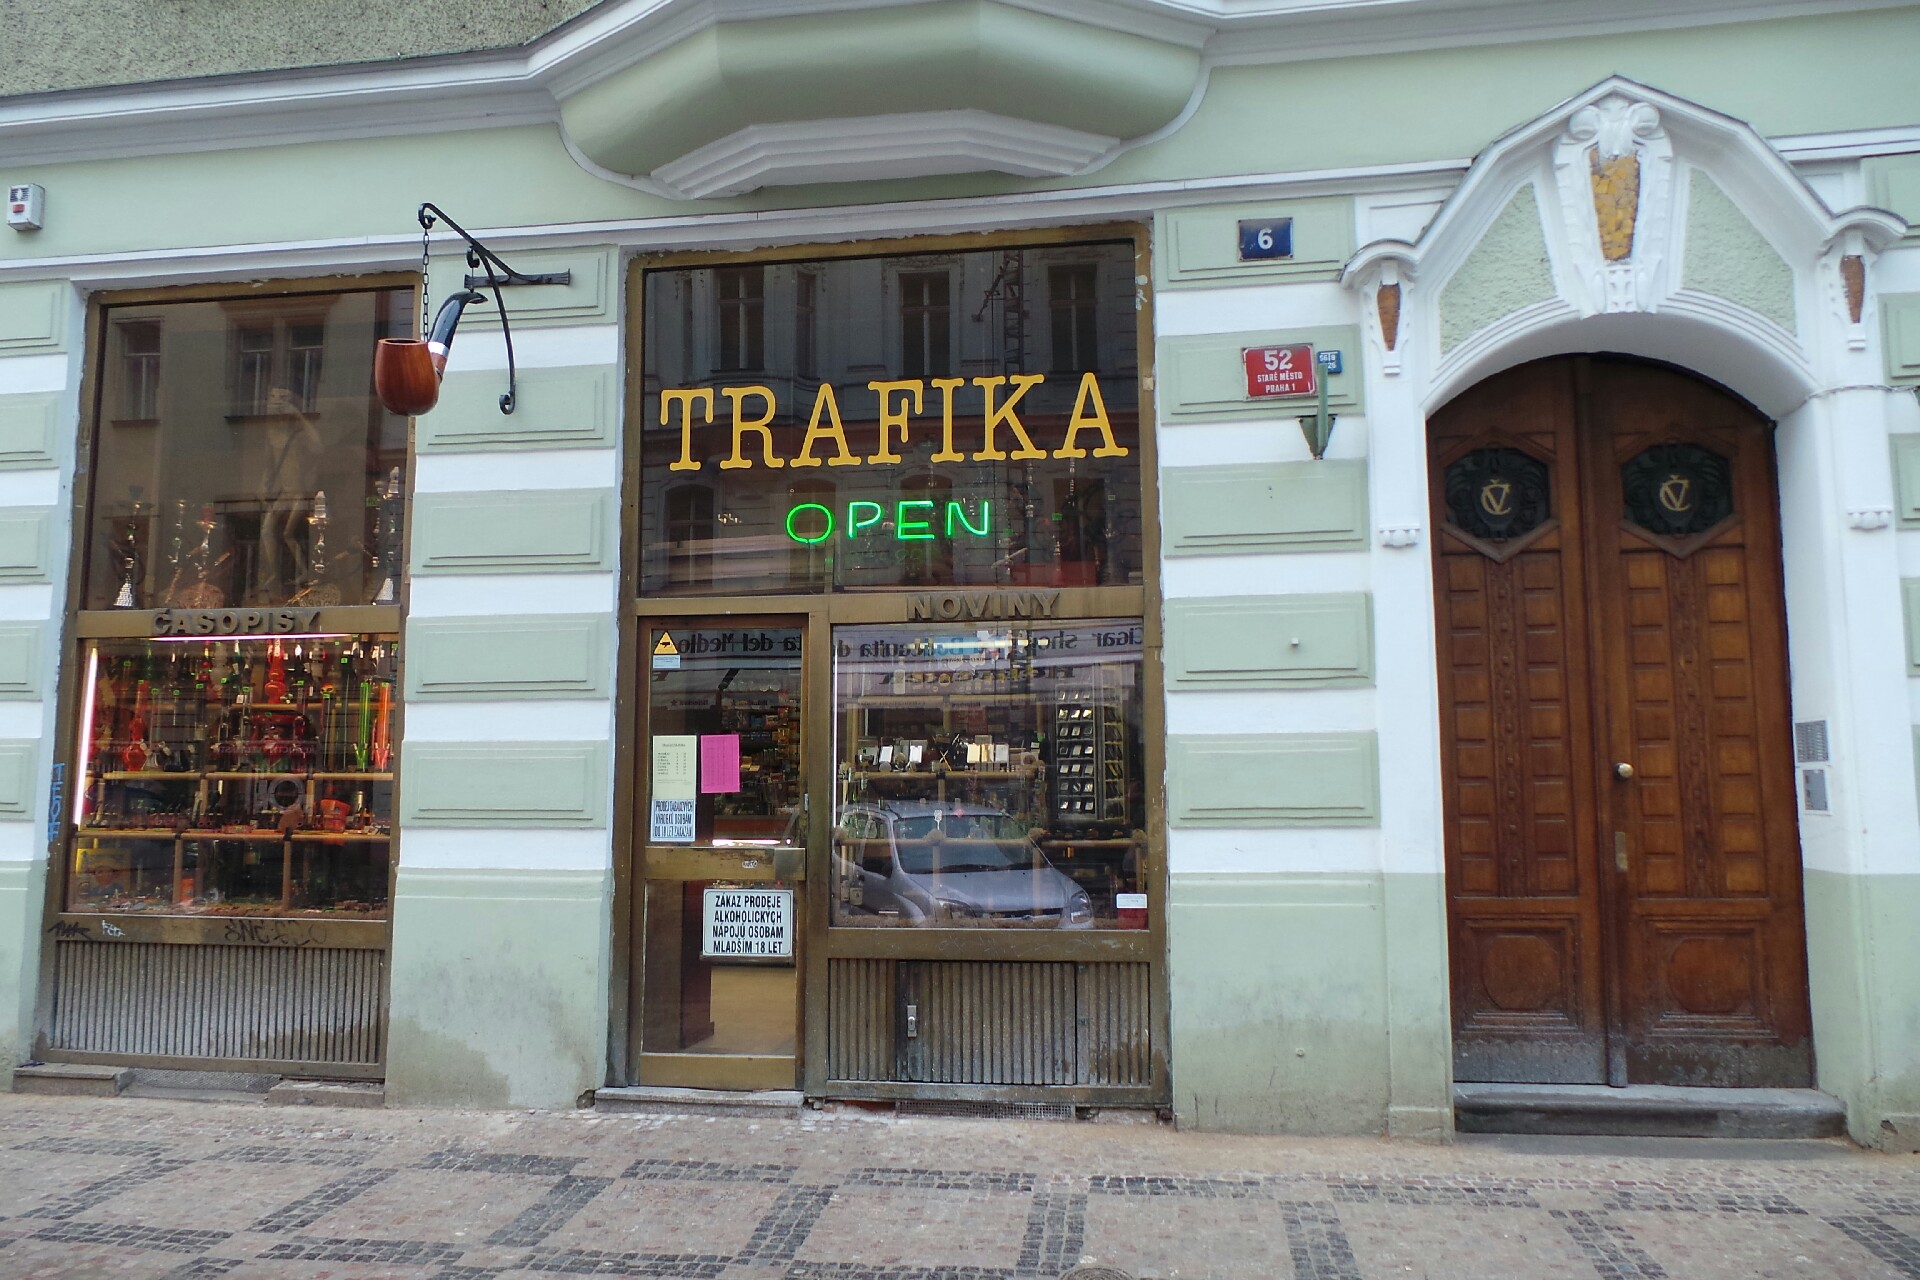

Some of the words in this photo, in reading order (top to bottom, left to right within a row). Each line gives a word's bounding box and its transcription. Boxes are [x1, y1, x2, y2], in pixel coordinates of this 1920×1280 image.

[1257, 228, 1273, 250] 6
[1264, 349, 1293, 371] 52
[1257, 372, 1278, 383] STARÉ
[1279, 371, 1303, 381] MĚSTO
[1265, 383, 1290, 393] PRAHA
[1291, 383, 1296, 391] 1
[660, 372, 1129, 471] TRAFIKA
[785, 500, 990, 545] OPEN
[907, 592, 1060, 620] NOVINY
[151, 608, 322, 635] ČASOPISY
[715, 892, 741, 908] ZÁKAZ
[744, 895, 781, 908] PRODEJE
[714, 908, 782, 923] ALKOHOLICKÝCH
[712, 923, 745, 938] NÁPOJŮ
[748, 923, 784, 938] OSOBÁM
[713, 938, 752, 953] MLADŠÍM
[755, 941, 766, 953] 18
[768, 941, 783, 954] LET
